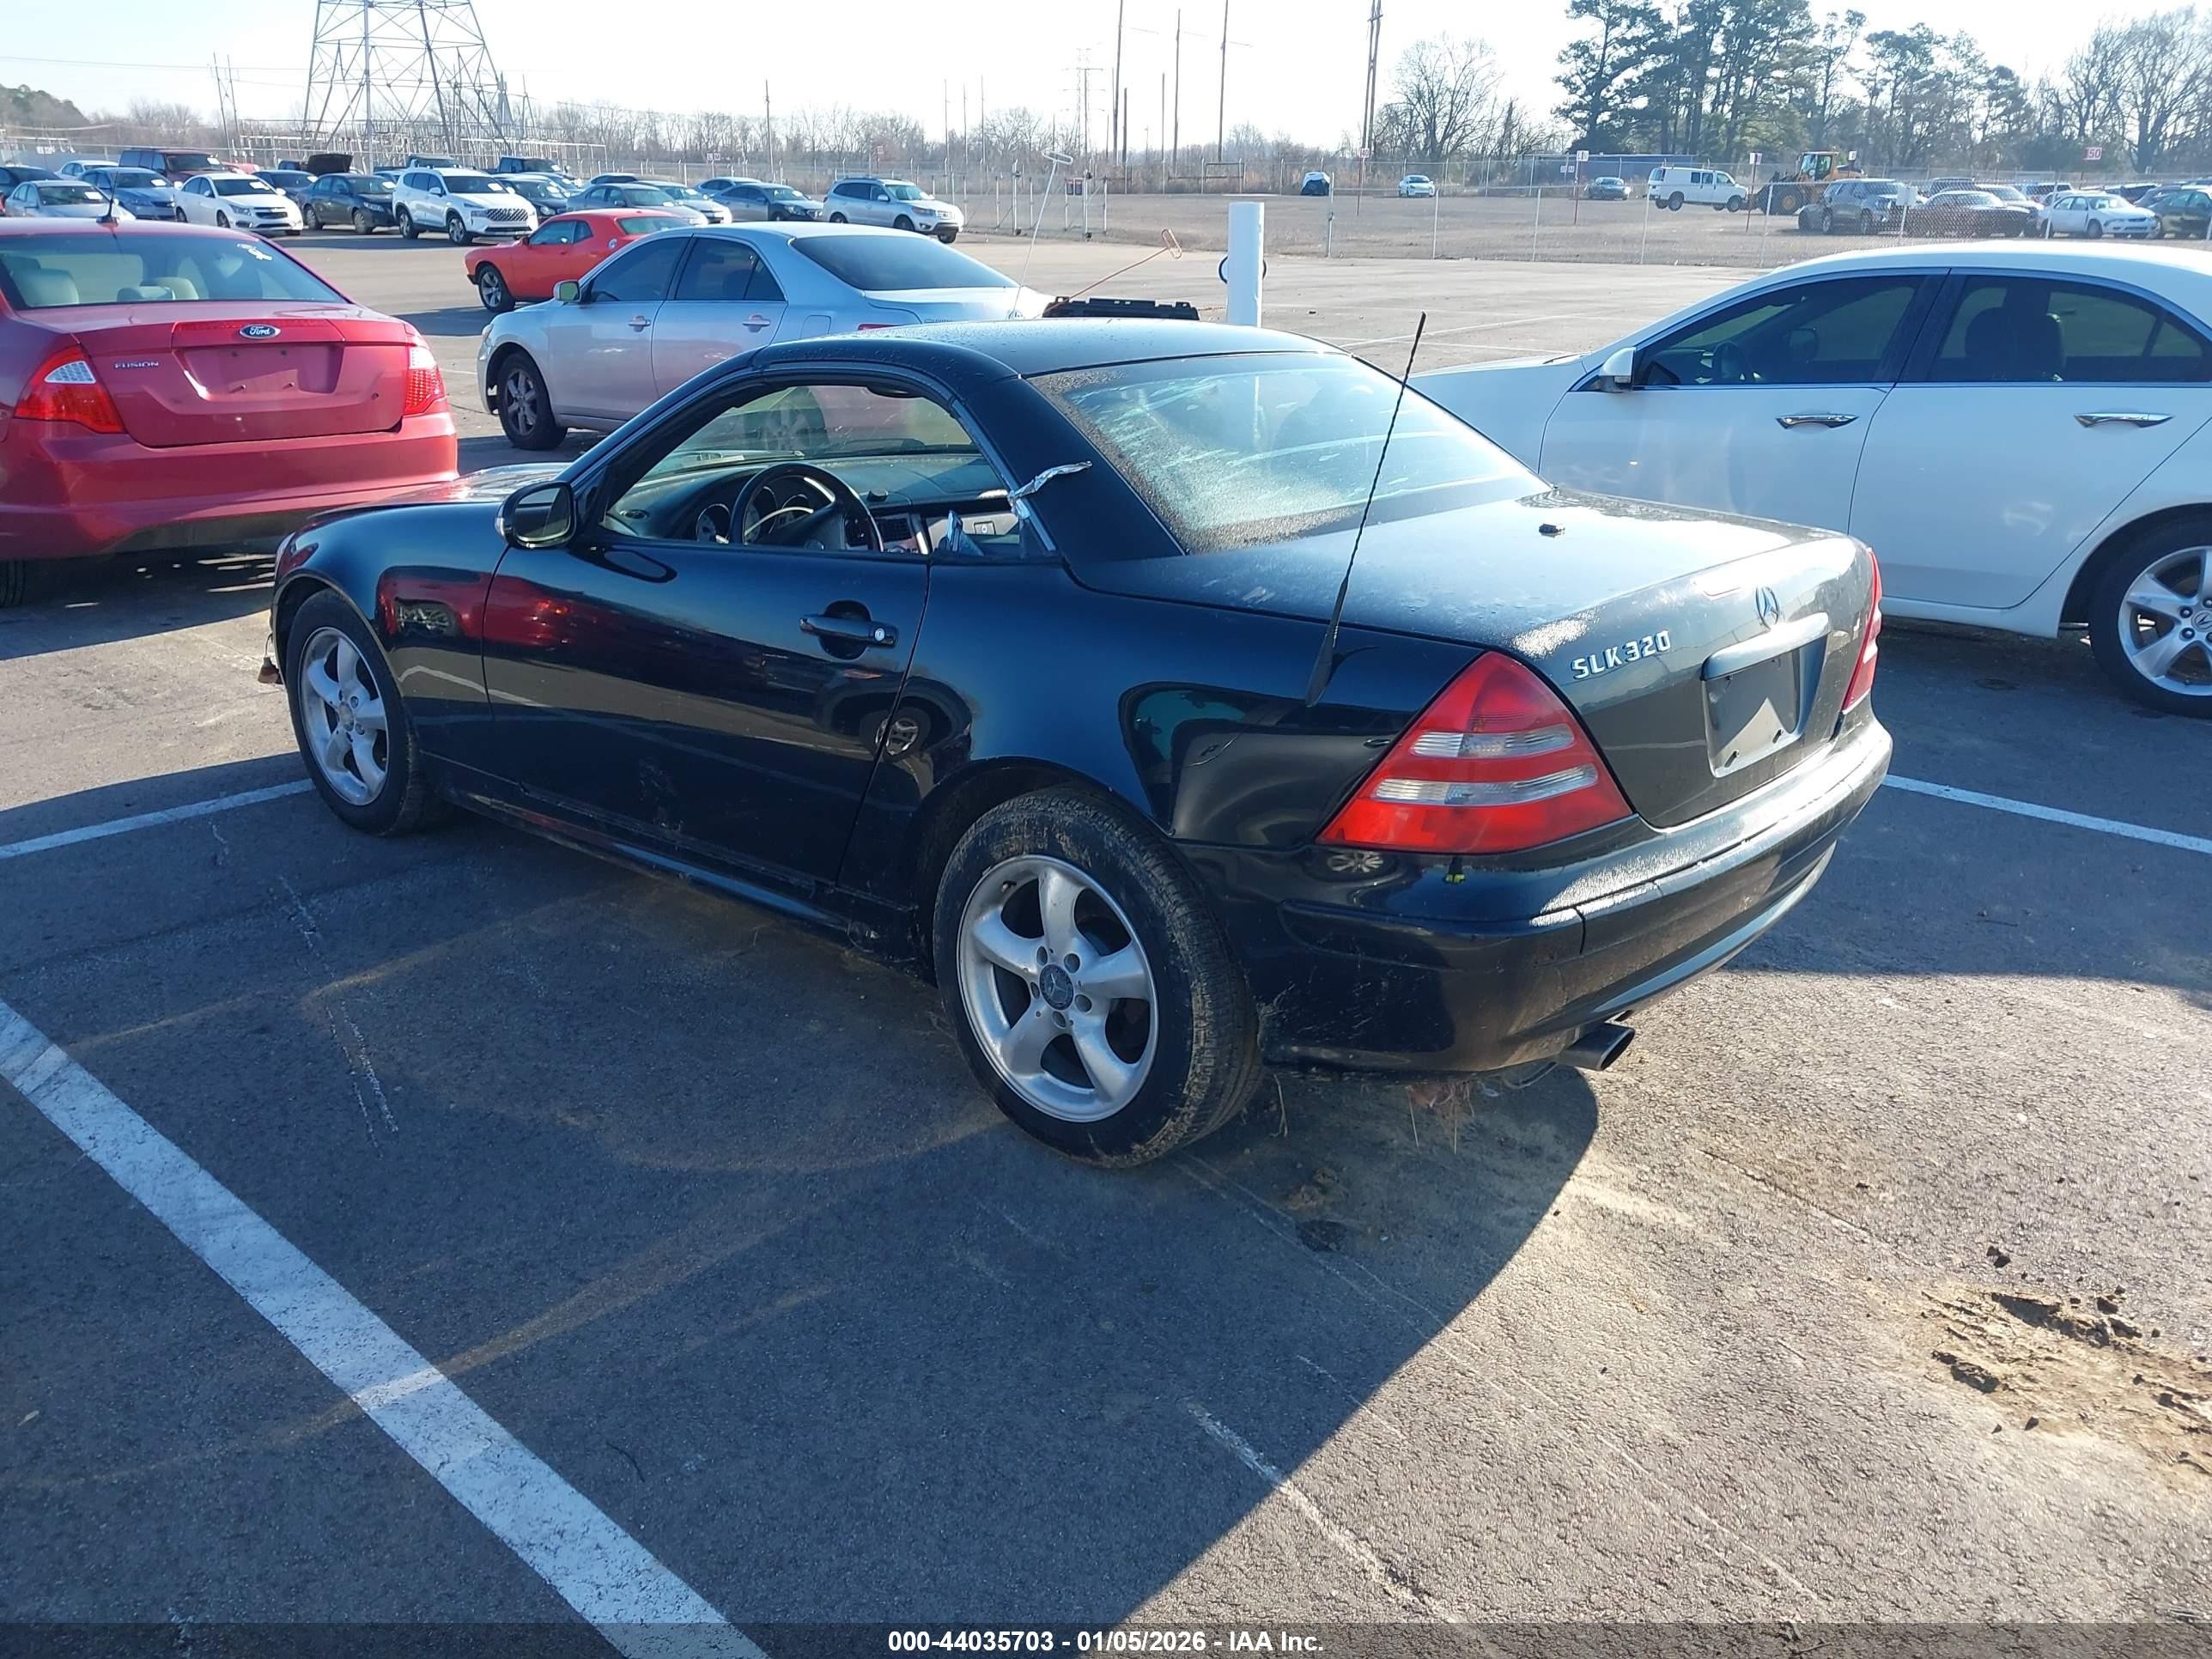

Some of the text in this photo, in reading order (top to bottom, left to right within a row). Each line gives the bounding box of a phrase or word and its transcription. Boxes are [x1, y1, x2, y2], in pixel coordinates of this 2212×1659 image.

[250, 326, 270, 336] Ford
[1571, 630, 1671, 679] SLK 320
